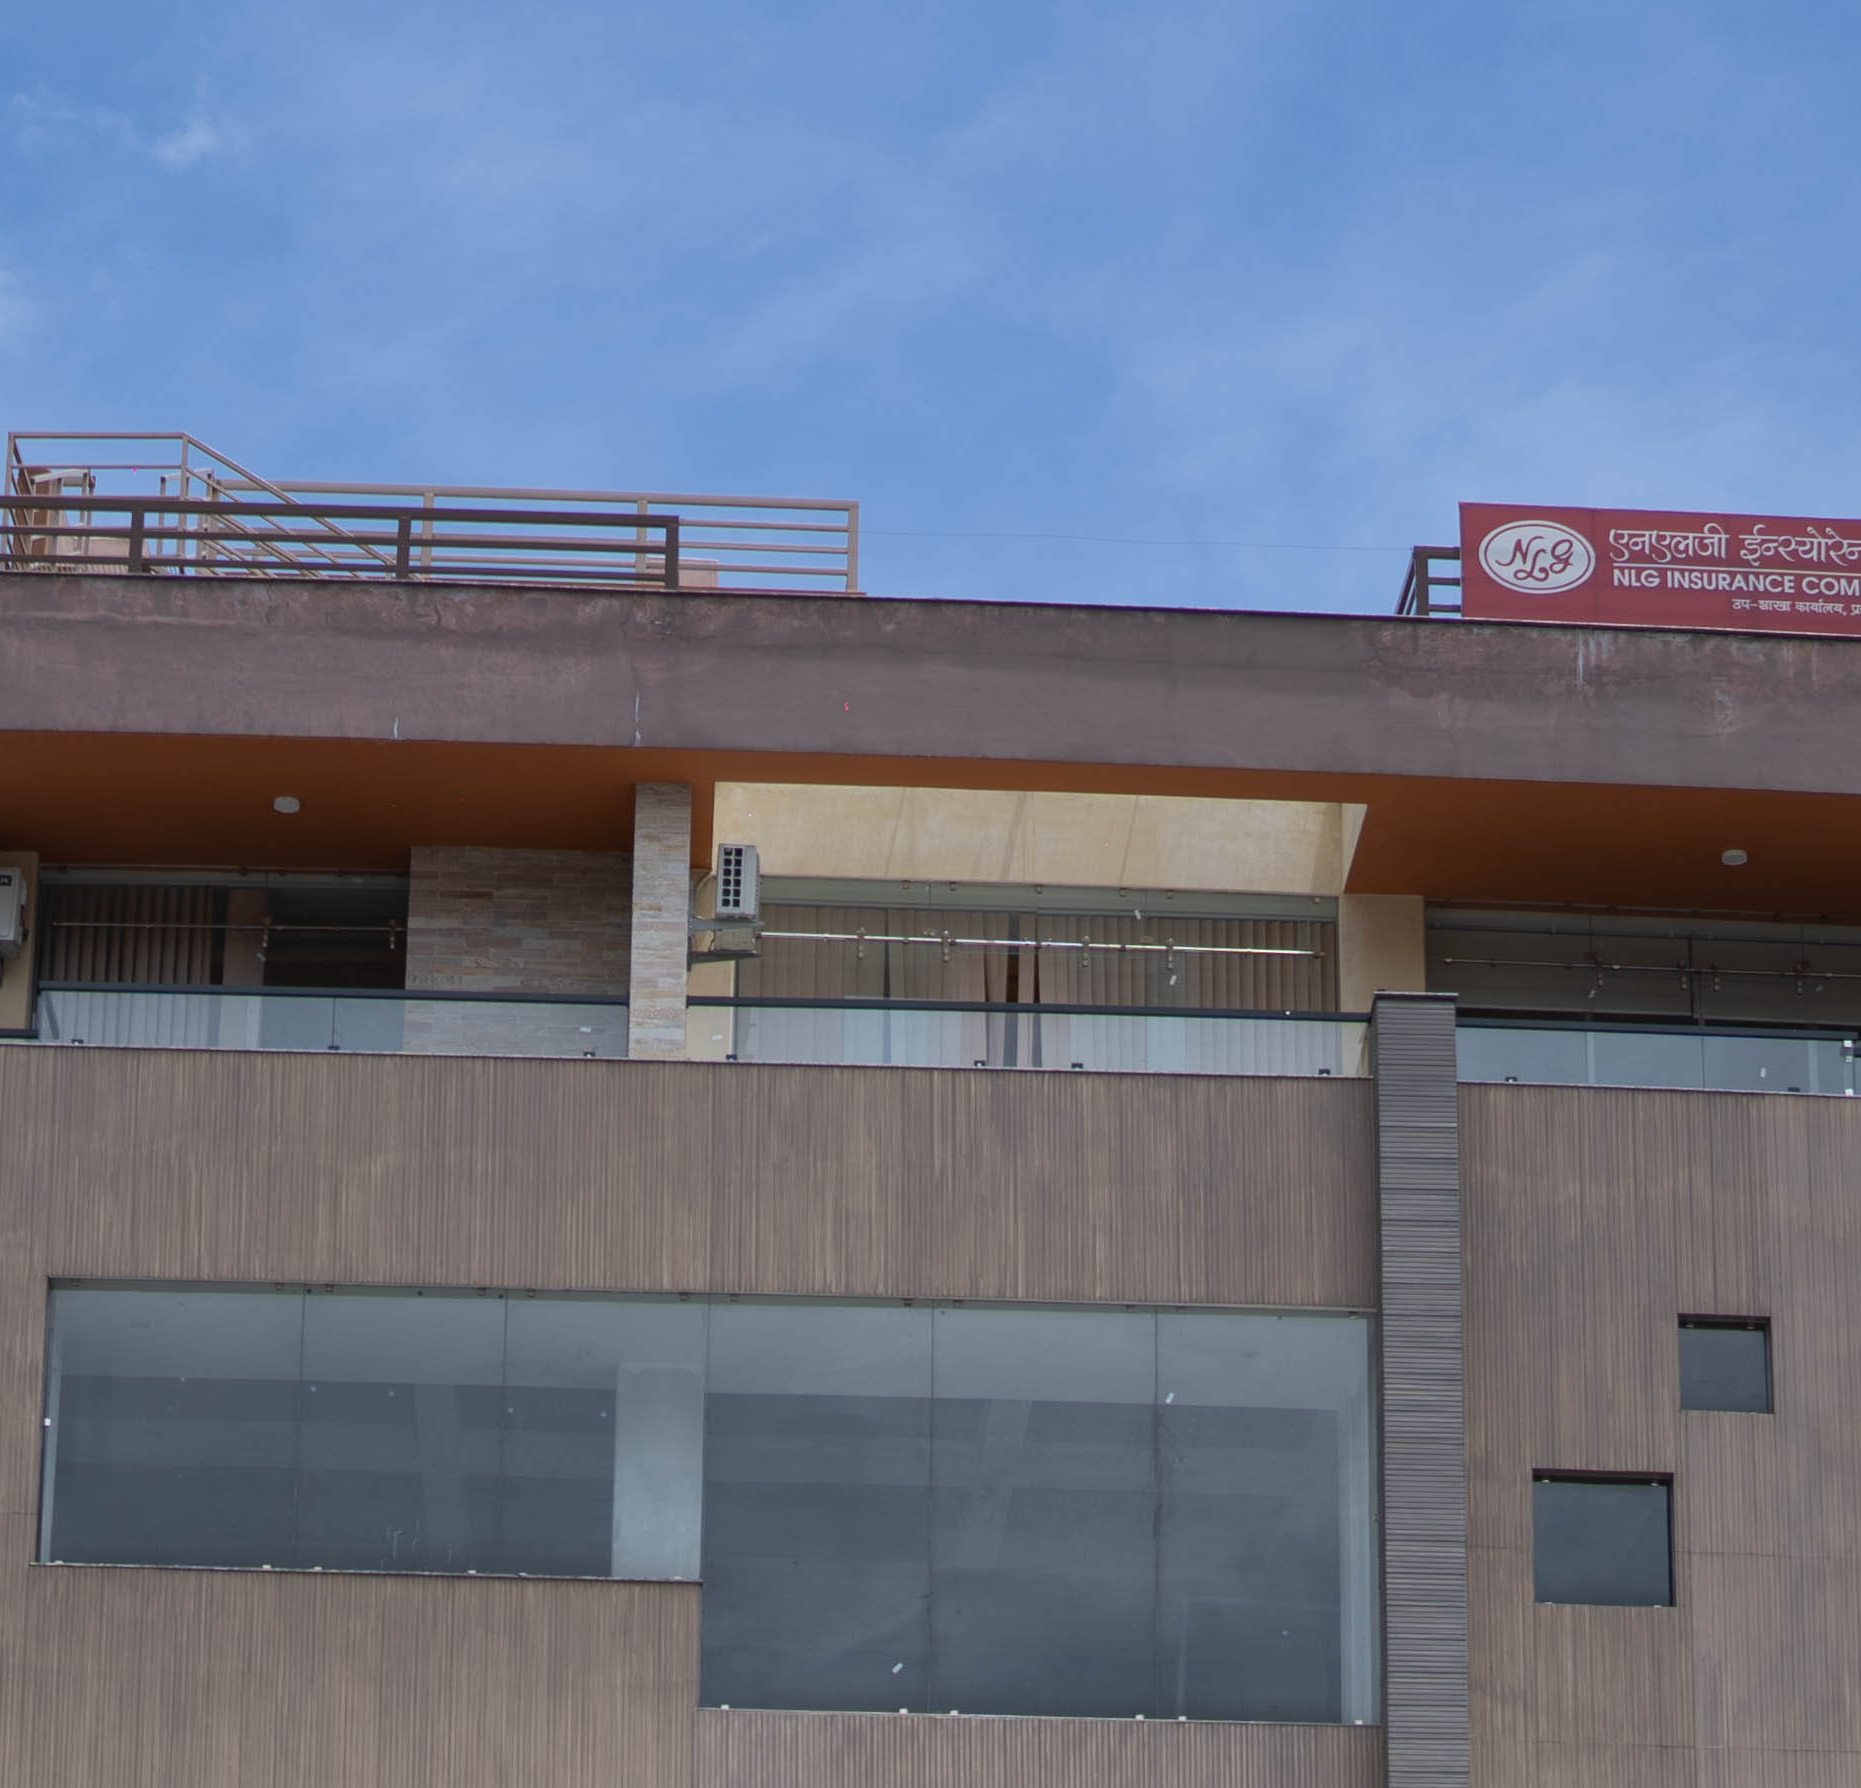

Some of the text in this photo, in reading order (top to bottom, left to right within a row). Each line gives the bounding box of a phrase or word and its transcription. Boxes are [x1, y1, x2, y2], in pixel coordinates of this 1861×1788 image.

[1609, 523, 1729, 562] एनएलजी
[1613, 569, 1660, 587] NLG
[1667, 570, 1795, 594] INSURANCE
